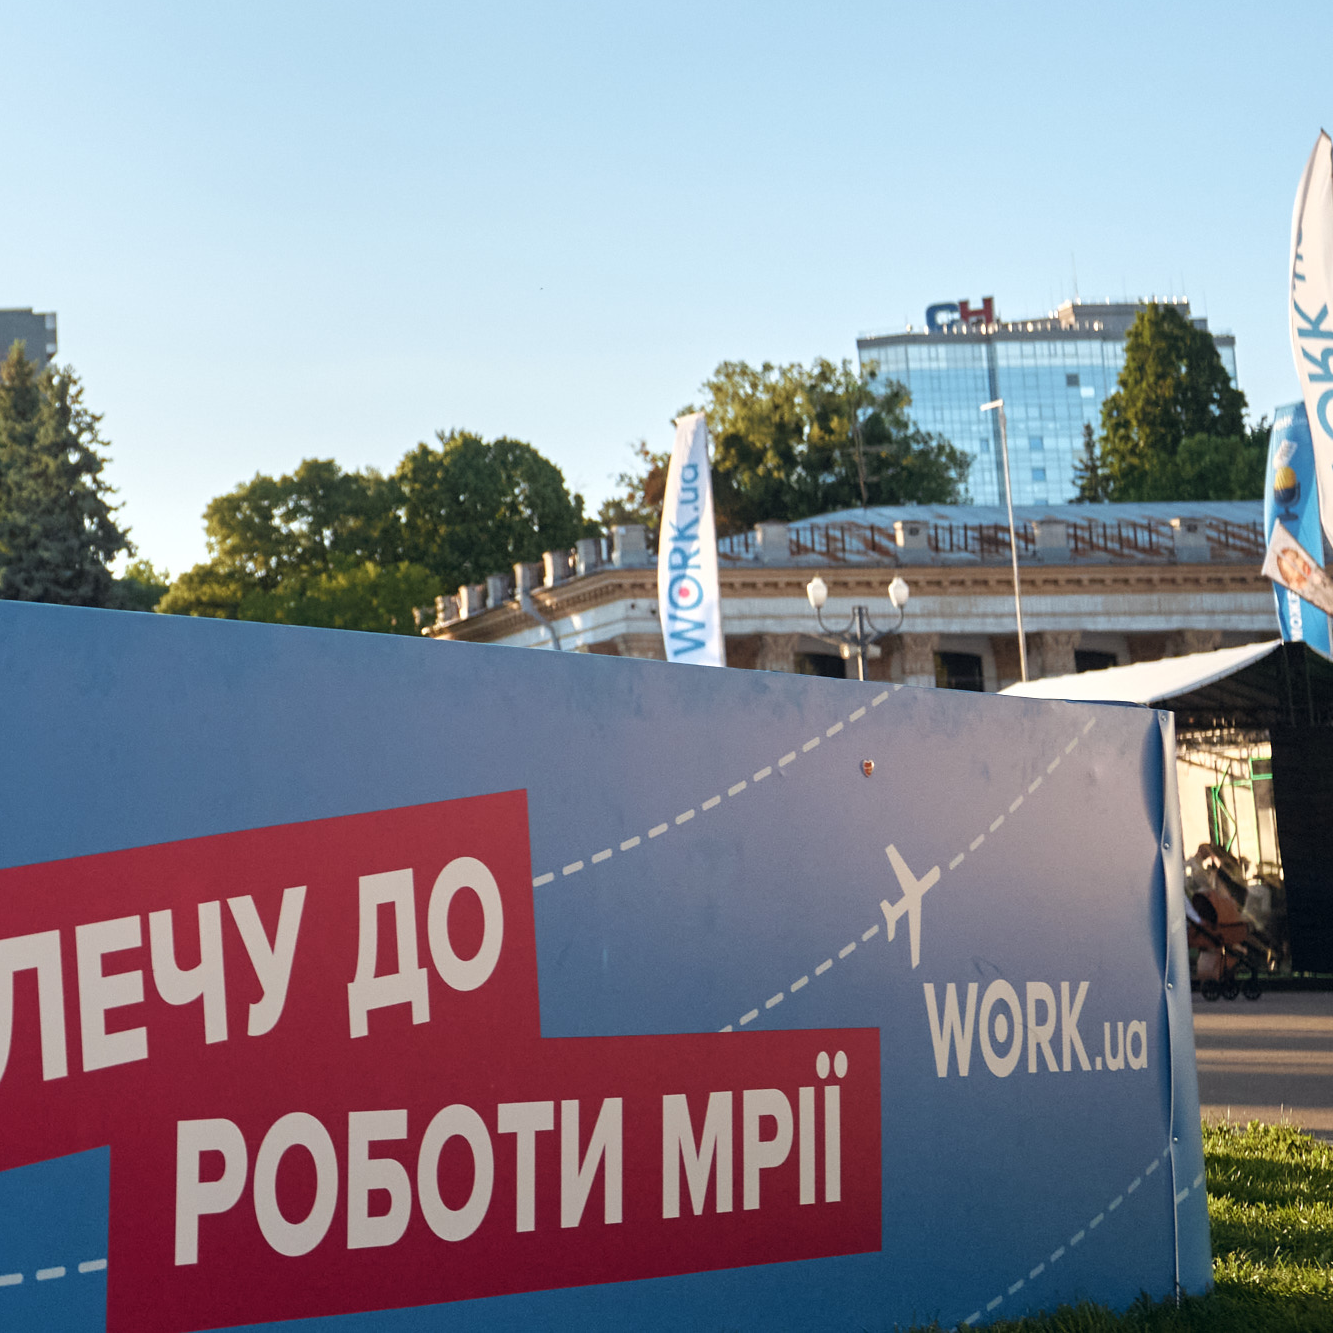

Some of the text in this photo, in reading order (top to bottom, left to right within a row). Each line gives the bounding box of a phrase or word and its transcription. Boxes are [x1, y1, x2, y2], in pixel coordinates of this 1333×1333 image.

[668, 463, 706, 657] WORK.ua
[347, 856, 504, 1039] ДО
[923, 979, 1148, 1078] WORK.ua
[175, 1051, 848, 1266] РОБОТИ МРІЇ
